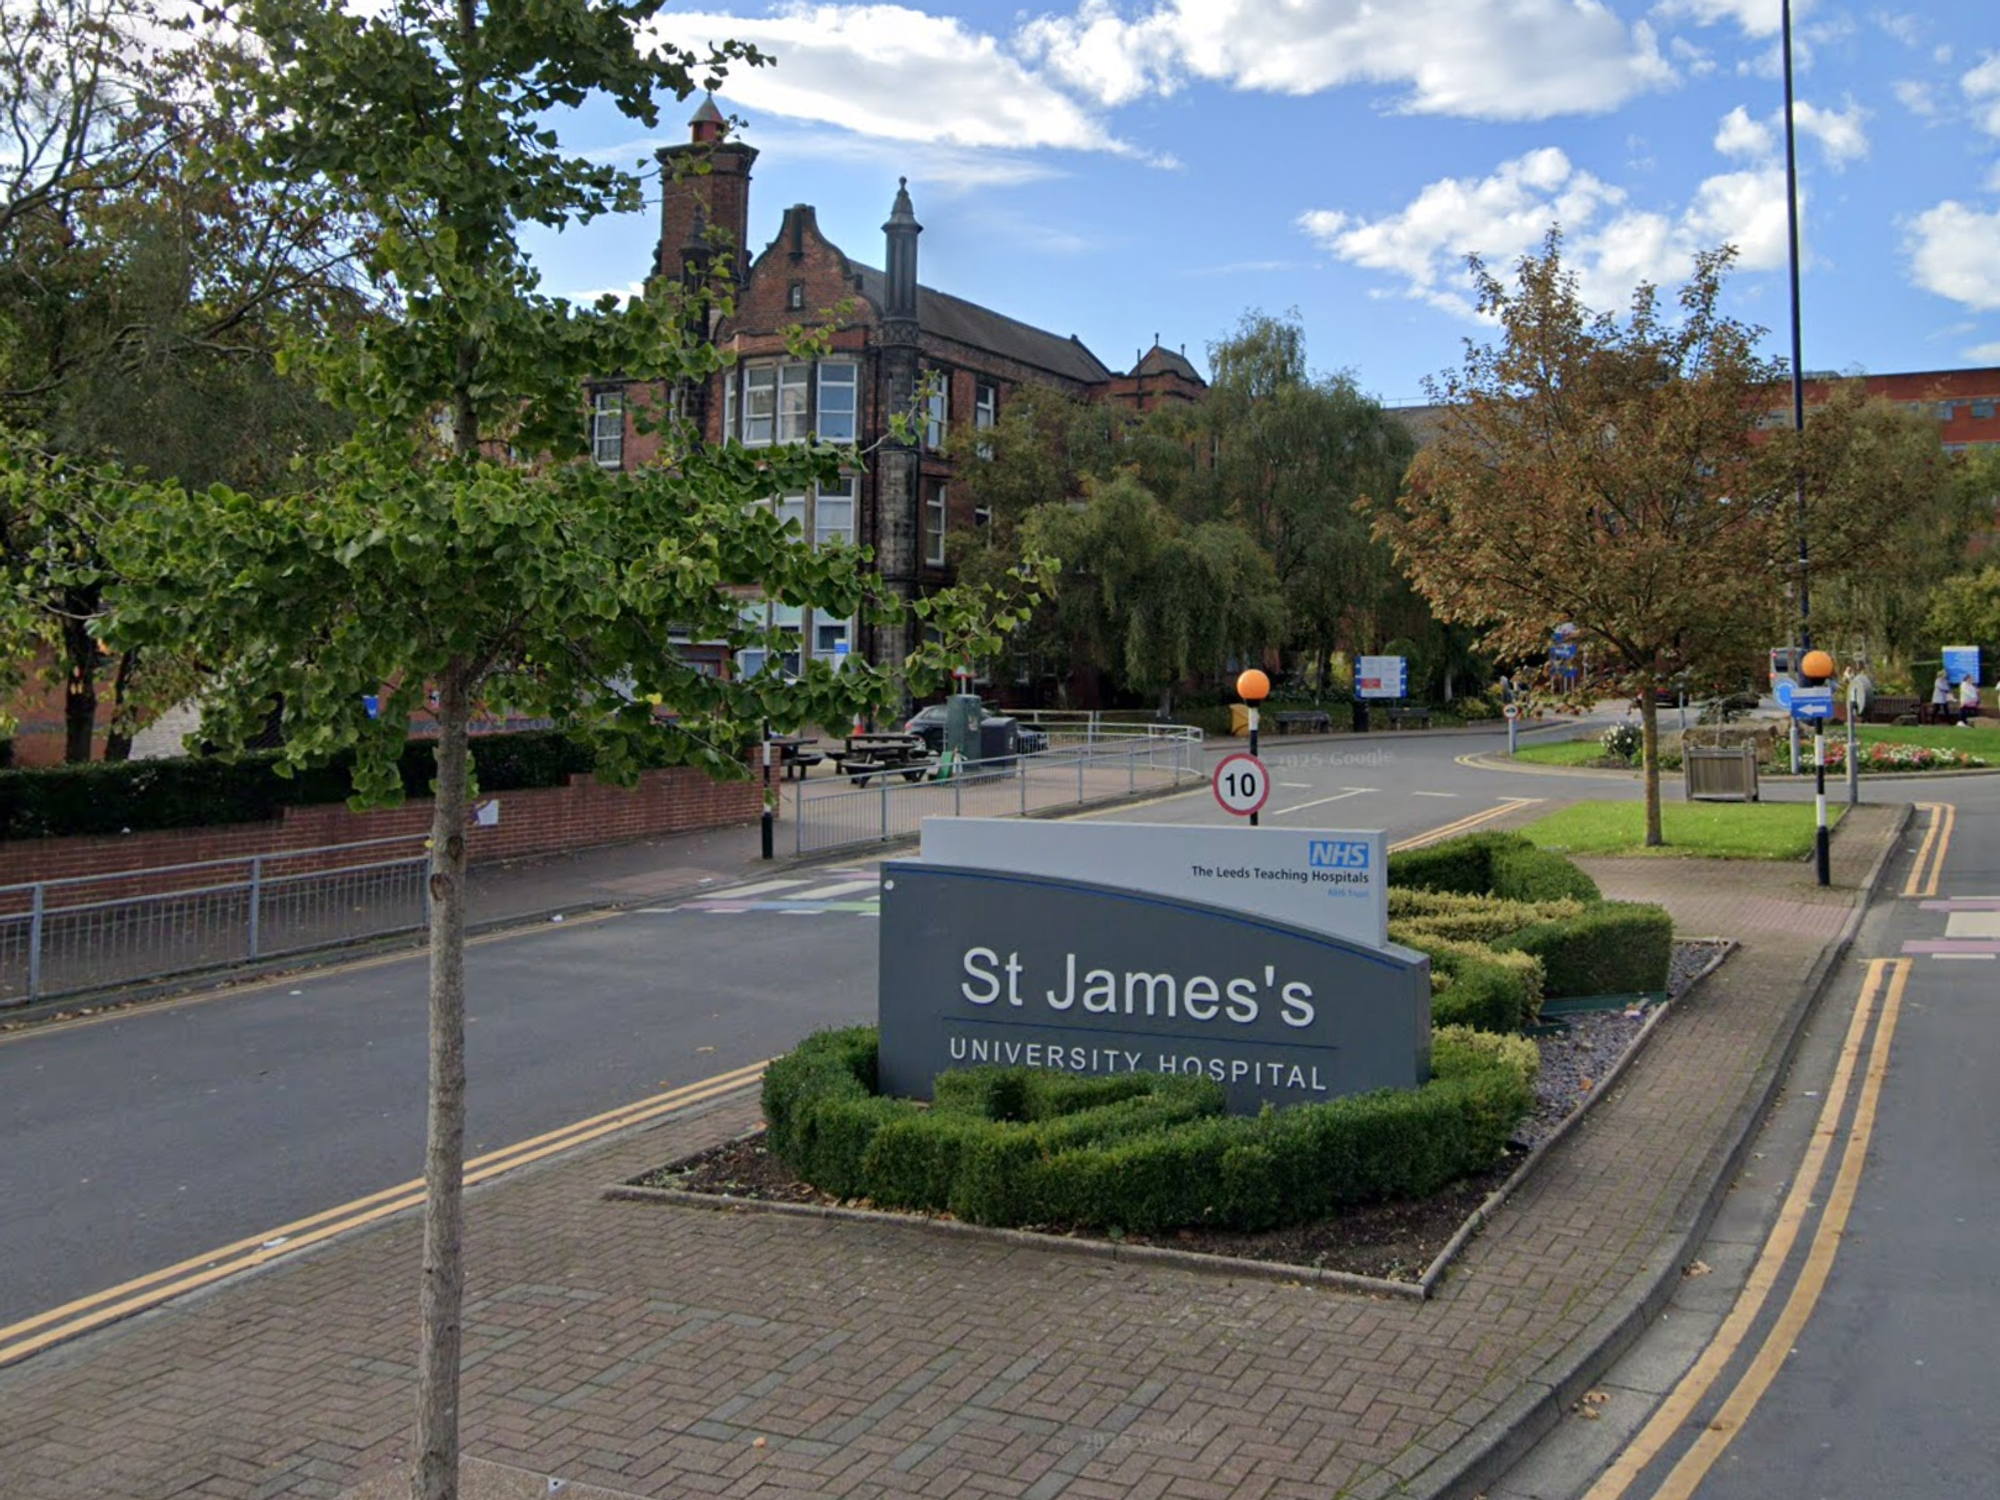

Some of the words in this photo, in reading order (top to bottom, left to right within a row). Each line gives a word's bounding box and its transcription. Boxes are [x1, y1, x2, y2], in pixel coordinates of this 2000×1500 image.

[1225, 773, 1256, 798] 10
[1311, 842, 1367, 867] NHS
[1192, 866, 1213, 878] The
[1216, 867, 1250, 879] Leeds
[1253, 868, 1308, 884] Teaching
[1312, 870, 1369, 884] Hospitals
[961, 946, 1024, 1007] St
[1046, 952, 1316, 1028] James's
[950, 1037, 1141, 1072] UNIVERSITY
[1159, 1054, 1327, 1091] HOSPITAL
